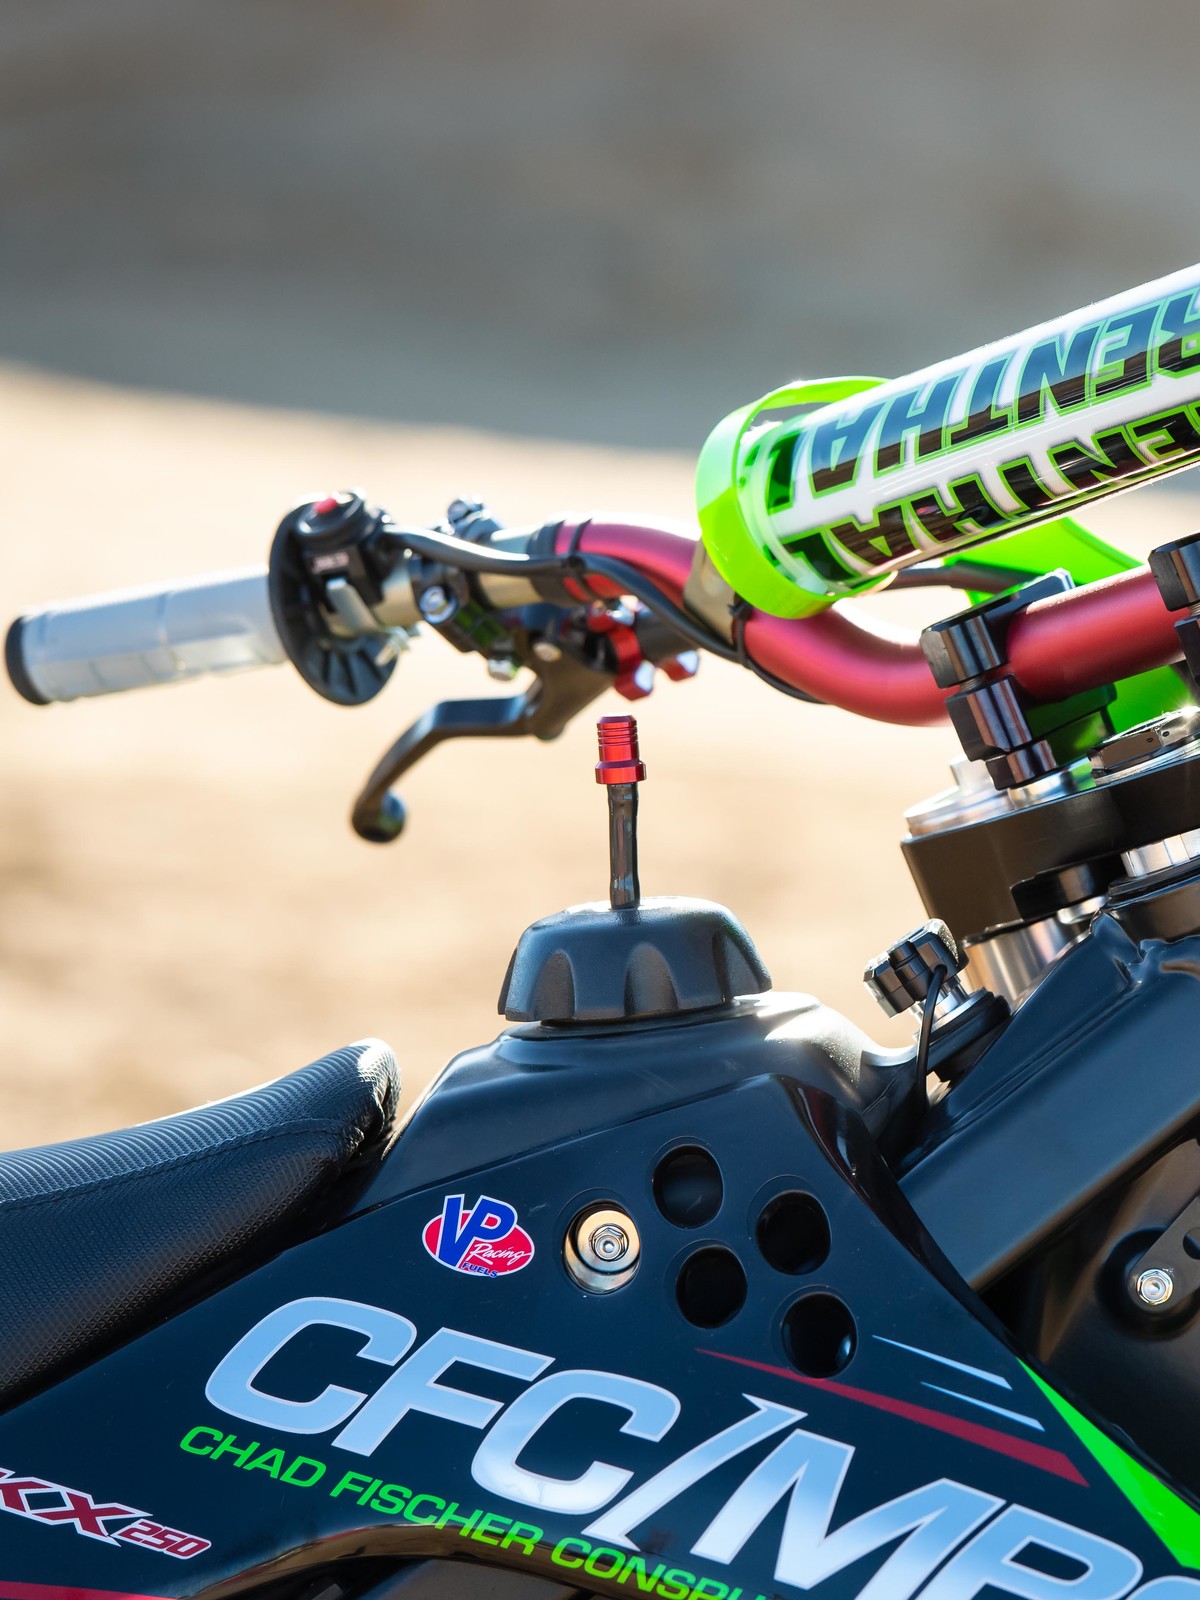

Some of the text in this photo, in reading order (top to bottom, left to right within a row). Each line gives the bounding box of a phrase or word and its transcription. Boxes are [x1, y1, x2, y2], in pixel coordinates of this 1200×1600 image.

[436, 1193, 518, 1269] VP
[462, 1262, 498, 1278] FUELS
[467, 1243, 531, 1265] Racing
[180, 1426, 326, 1487] CHAD
[330, 1470, 544, 1555] FISCHER
[110, 1518, 211, 1560] 250
